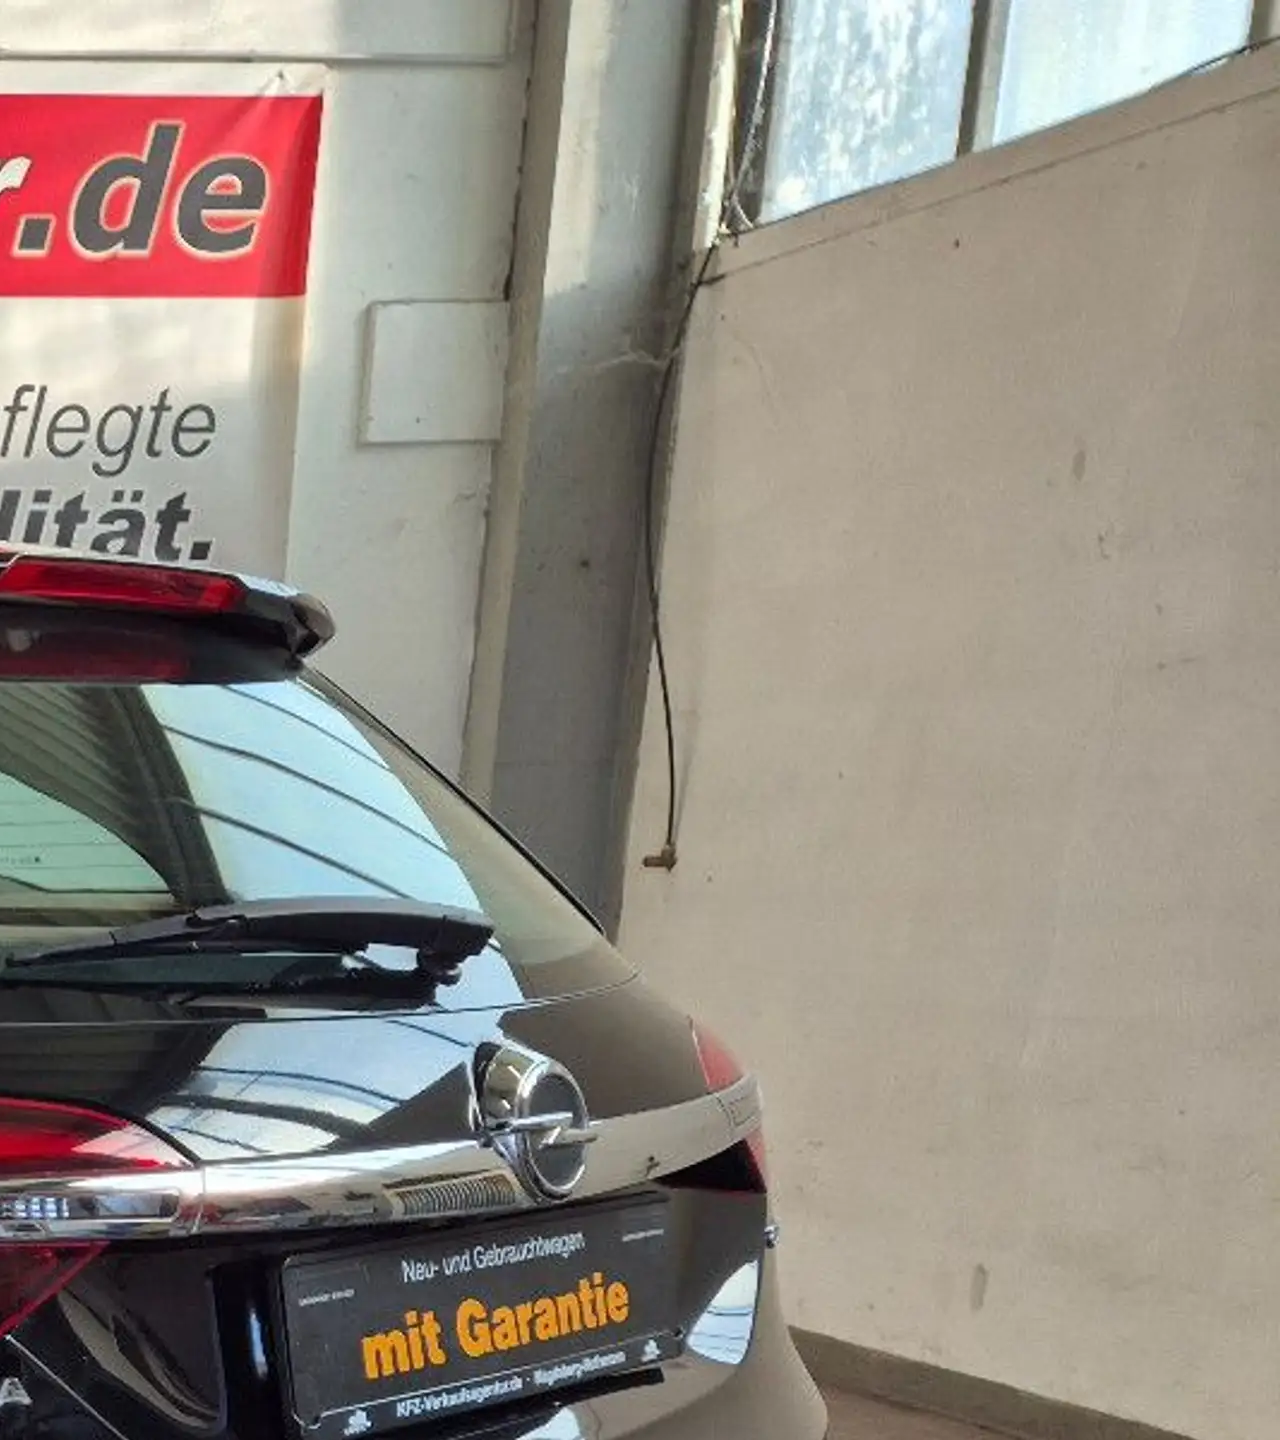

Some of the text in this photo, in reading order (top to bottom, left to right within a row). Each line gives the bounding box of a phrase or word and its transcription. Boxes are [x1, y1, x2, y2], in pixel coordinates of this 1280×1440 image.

[402, 1231, 586, 1283] Neu- und Gebrauchtwagen
[361, 1271, 630, 1380] mit Garantie
